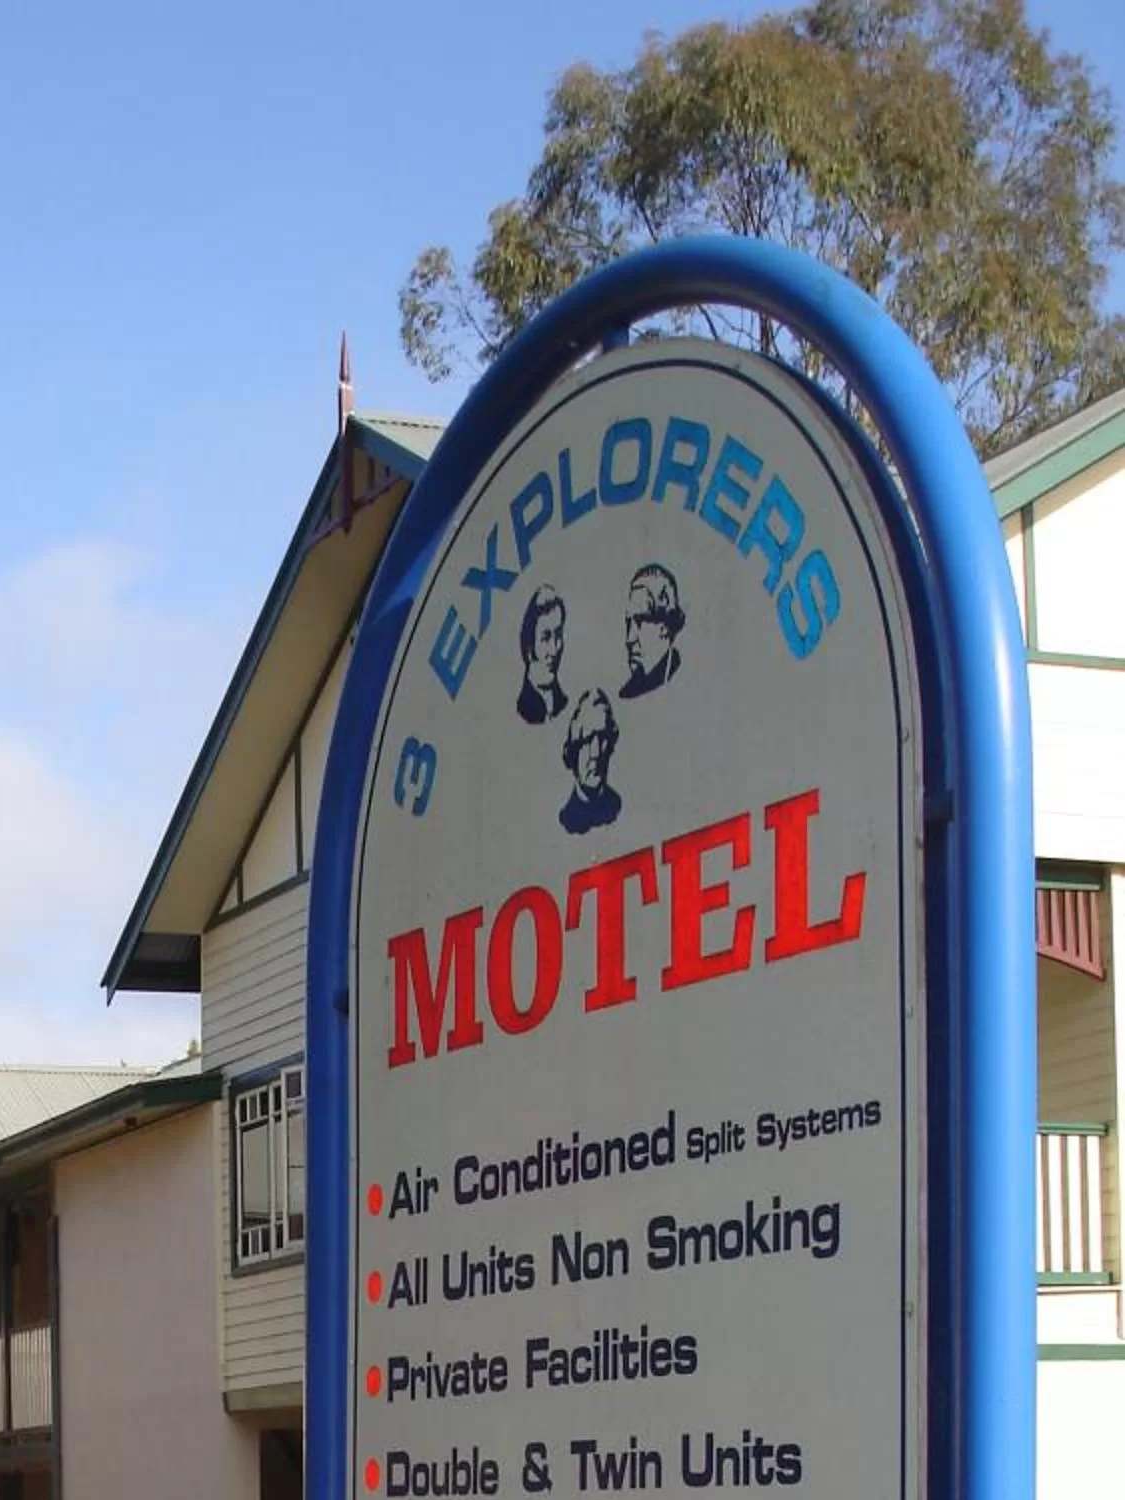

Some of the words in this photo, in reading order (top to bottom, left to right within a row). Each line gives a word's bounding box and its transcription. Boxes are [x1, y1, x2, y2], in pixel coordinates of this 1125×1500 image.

[393, 736, 437, 817] 3
[428, 416, 841, 701] EXPLORERS
[387, 788, 867, 1067] MOTEL
[389, 1167, 438, 1219] Air
[454, 1110, 675, 1205] Conditioned
[686, 1121, 745, 1163] Split
[756, 1098, 882, 1150] Systems
[388, 1257, 428, 1308] All
[442, 1245, 535, 1301] Units
[551, 1231, 630, 1285] Non
[647, 1196, 841, 1270] Smoking
[387, 1352, 508, 1402] Private
[525, 1325, 698, 1388] Facilities
[386, 1447, 499, 1497] Double
[522, 1441, 552, 1492] &
[571, 1437, 662, 1490] Twin
[681, 1430, 802, 1487] Units
